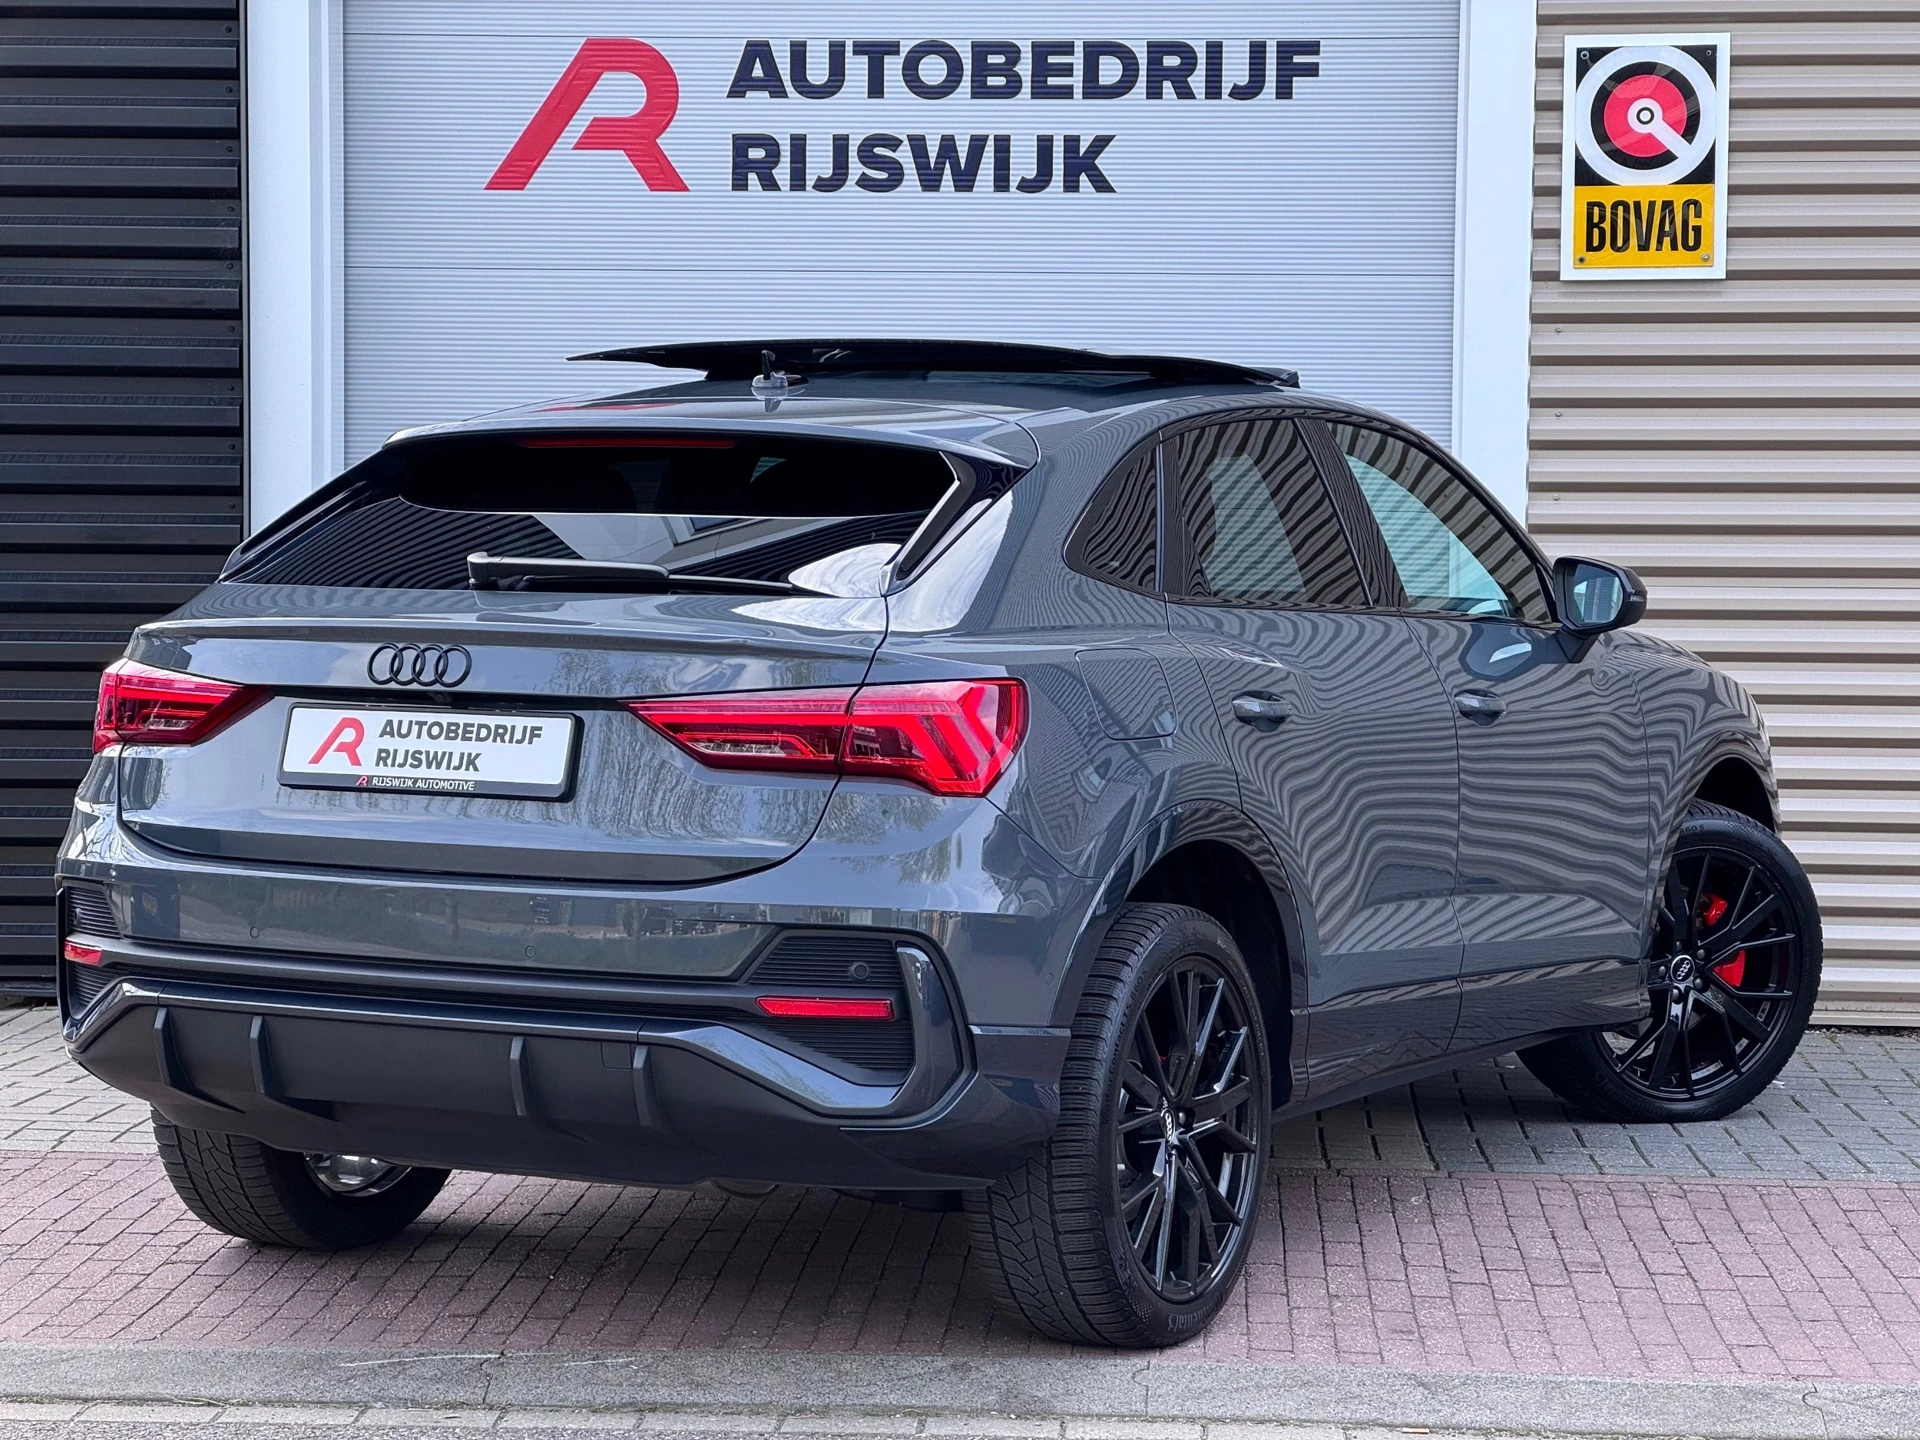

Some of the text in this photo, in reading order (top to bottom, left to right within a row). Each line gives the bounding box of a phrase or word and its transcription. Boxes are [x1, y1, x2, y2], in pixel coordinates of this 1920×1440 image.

[727, 40, 1321, 101] AUTOBEDRIJF
[731, 133, 1117, 193] RIJSWIJK
[1586, 198, 1702, 253] BOVAG
[378, 719, 543, 745] AUTOBEDRIJF
[374, 748, 482, 772] RIJSWIJK
[372, 776, 414, 788] RIJSWIJK
[415, 778, 475, 791] AUTOMOTIVE
